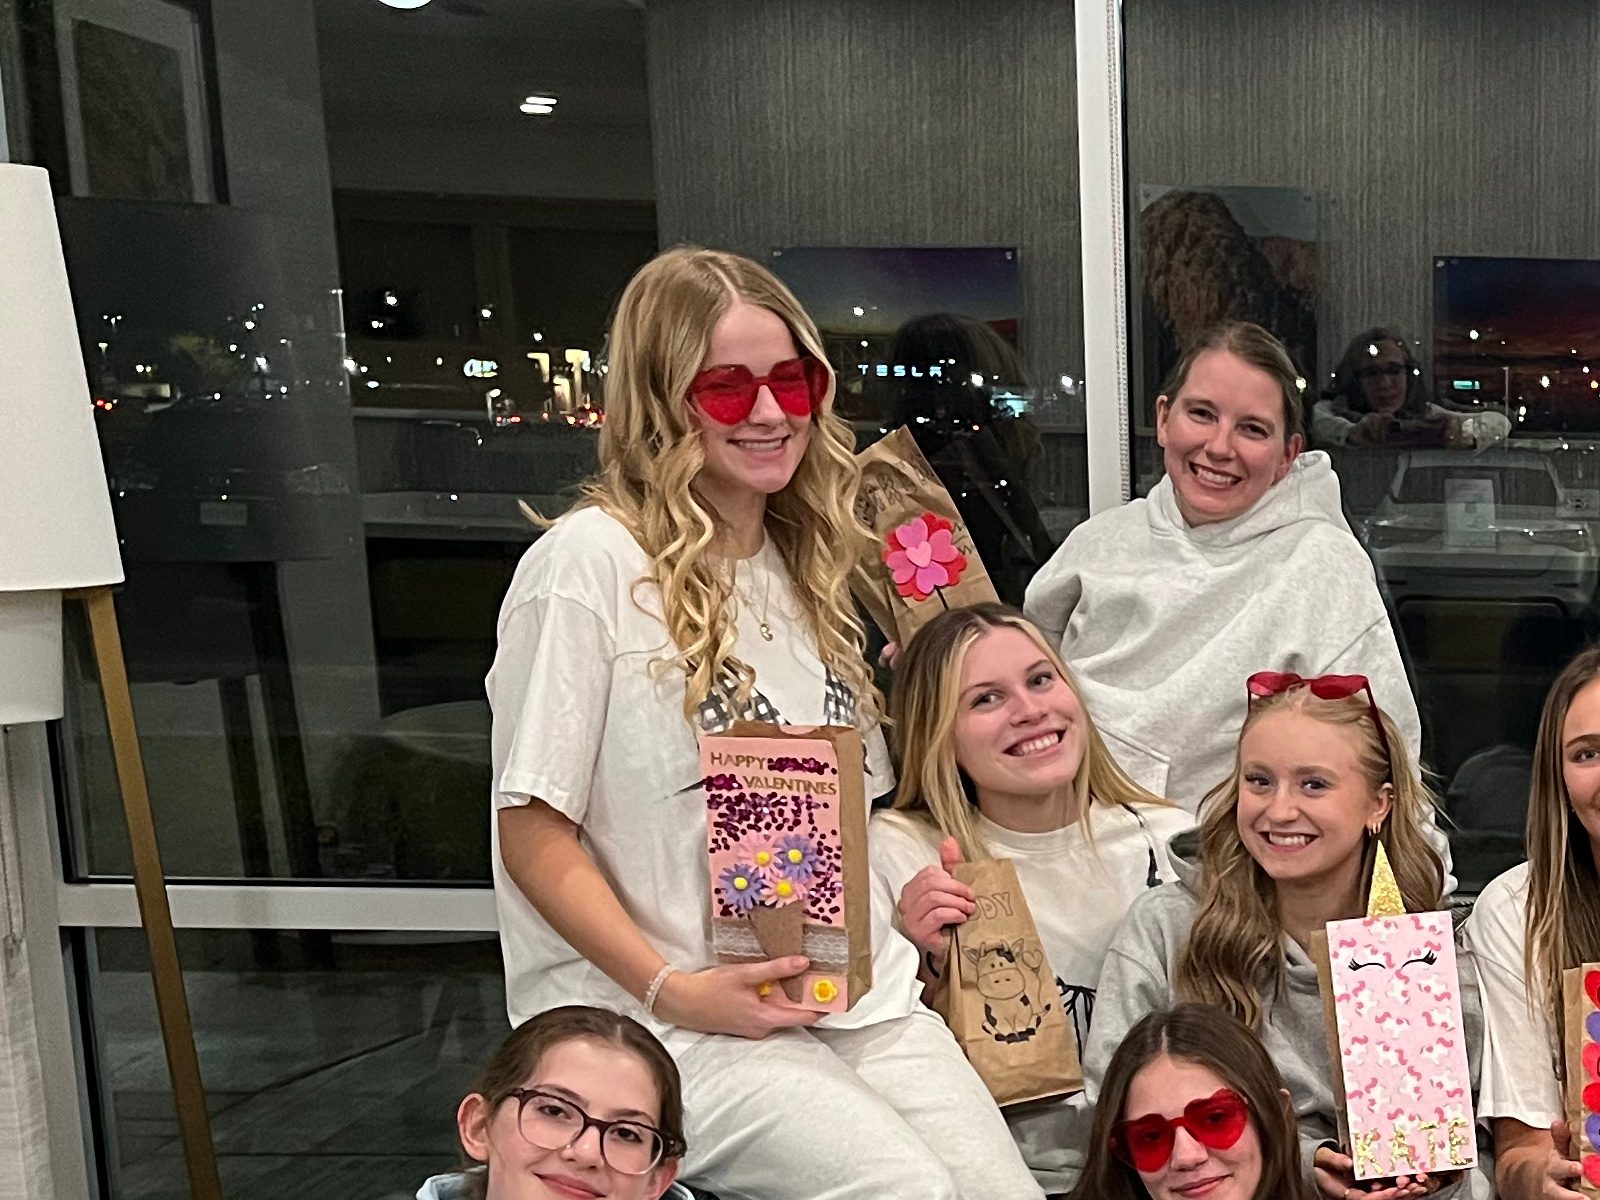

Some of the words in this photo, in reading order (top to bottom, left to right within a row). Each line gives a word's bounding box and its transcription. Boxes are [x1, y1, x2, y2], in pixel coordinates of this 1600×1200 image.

[857, 364, 942, 378] TESLA
[710, 751, 766, 770] HAPPY
[742, 775, 837, 795] VALENTINES
[1354, 1116, 1473, 1177] KATE
